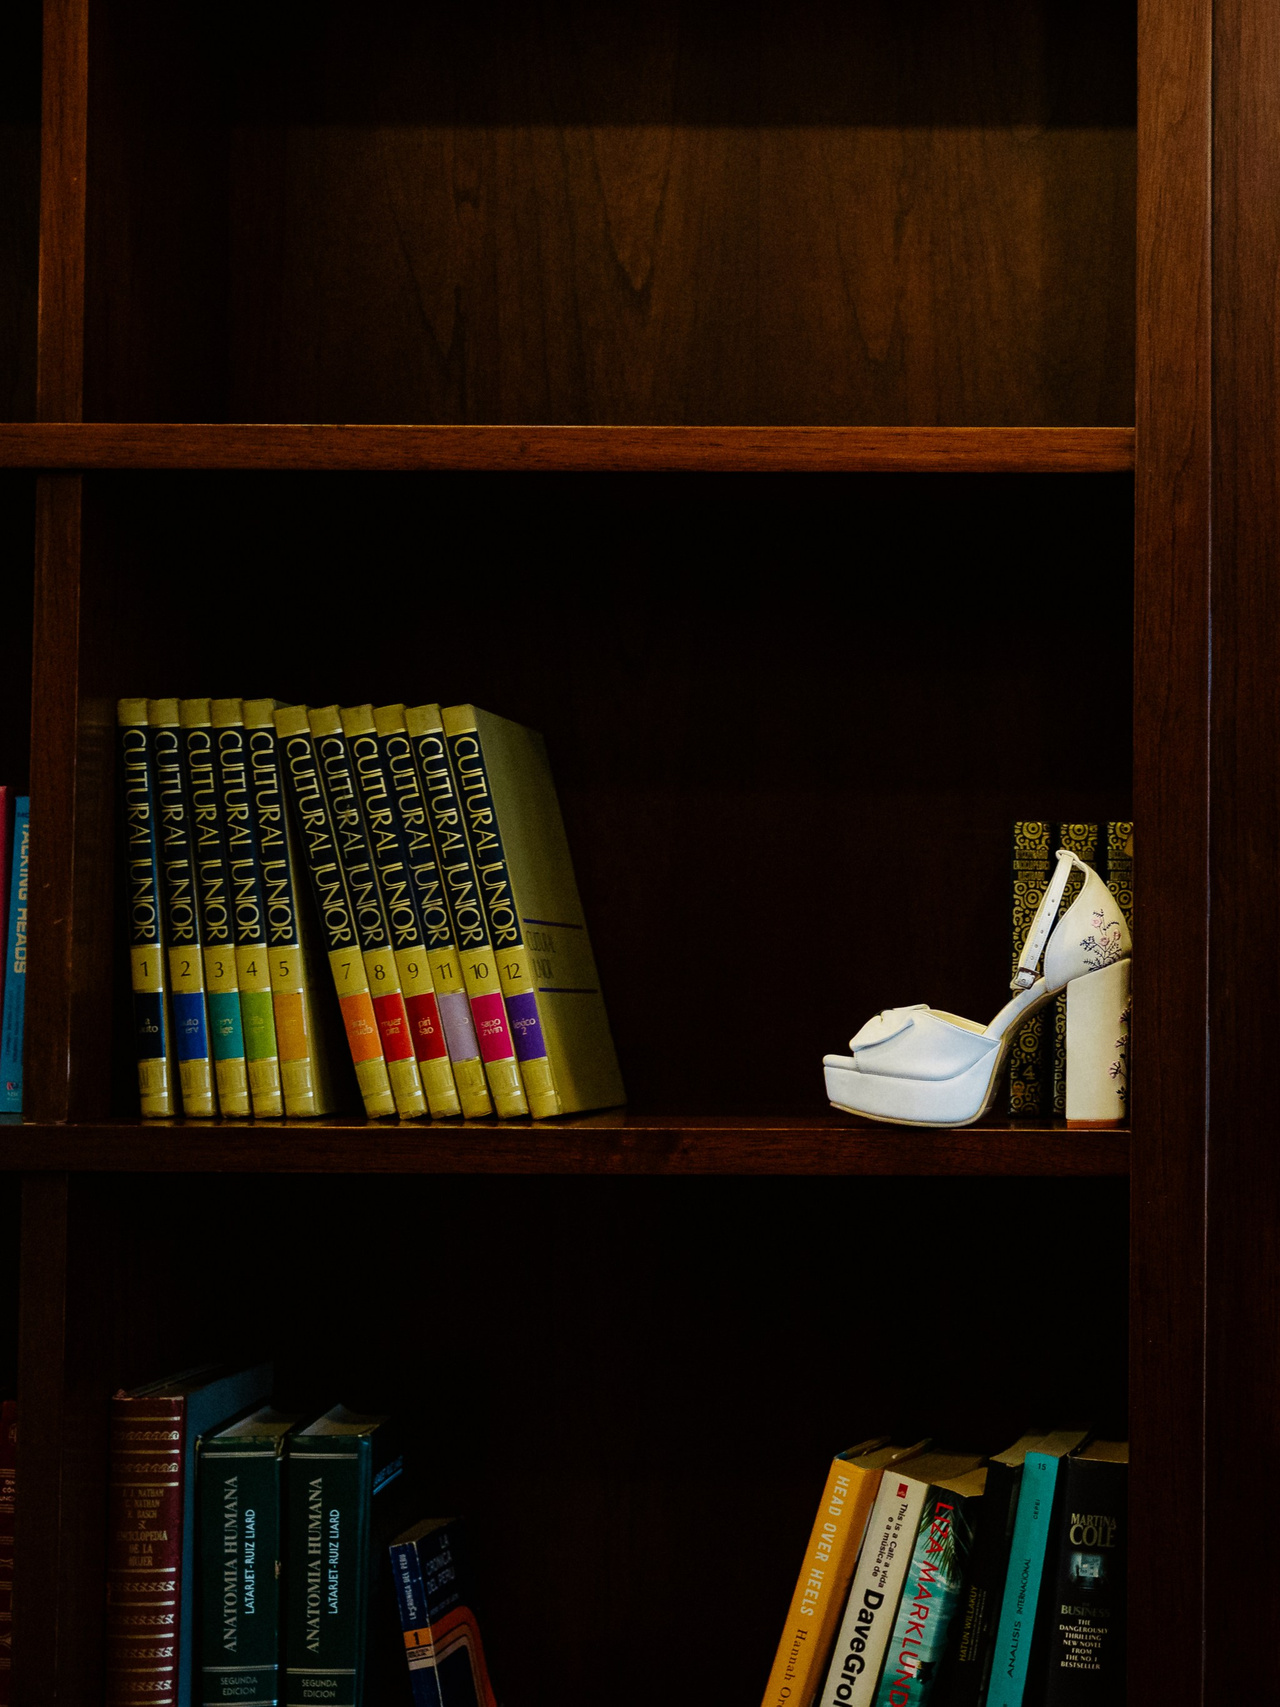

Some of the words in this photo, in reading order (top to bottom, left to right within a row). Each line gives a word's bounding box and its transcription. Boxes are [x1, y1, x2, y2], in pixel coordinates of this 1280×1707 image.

[122, 730, 151, 852] CULTURAL
[154, 730, 187, 853] CULTURAL
[187, 730, 220, 853] CULTURAL
[218, 730, 252, 853] CULTURAL
[250, 731, 284, 854] CULTURAL
[286, 737, 332, 859] CULTURAL
[309, 862, 352, 947] JUNIOR
[320, 737, 365, 859] CULTURAL
[344, 862, 385, 946] JUNIOR
[353, 737, 399, 858] CULTURAL
[377, 862, 418, 946] JUNIOR
[386, 737, 431, 858] CULTURAL
[409, 862, 450, 946] JUNIOR
[418, 737, 465, 858] CULTURAL
[442, 862, 484, 946] JUNIOR
[454, 736, 499, 858] CULTURAL
[477, 862, 518, 946] JUNIOR
[129, 858, 156, 940] JUNIOR
[164, 859, 194, 942] JUNIOR
[198, 858, 229, 942] JUNIOR
[229, 858, 261, 942] JUNIOR
[260, 859, 293, 943] JUNIOR
[140, 961, 149, 977] 1
[180, 960, 191, 977] 2
[214, 961, 224, 978] 3
[246, 961, 258, 976] 4
[279, 960, 289, 977] 5
[341, 962, 351, 980] 7
[374, 964, 386, 981] 8
[407, 962, 419, 979] 9
[437, 962, 453, 980] 11
[471, 962, 489, 980] 10
[503, 962, 521, 980] 12
[418, 1017, 431, 1029] piri
[419, 1026, 434, 1035] sao
[480, 1018, 501, 1029] sapo
[1022, 1064, 1035, 1080] 4
[828, 1475, 851, 1517] HEAD
[223, 1476, 238, 1554] HUMANA
[244, 1509, 256, 1539] LIARD
[307, 1477, 323, 1556] HUMANA
[328, 1509, 340, 1539] LIARD
[894, 1523, 901, 1531] is
[896, 1503, 909, 1521] This
[926, 1501, 954, 1553] LIZA
[1070, 1513, 1117, 1530] MARTINA
[815, 1522, 837, 1563] OVER
[877, 1535, 890, 1565] música
[1069, 1524, 1117, 1548] COLE
[244, 1541, 256, 1614] LATARJET-RUIZ
[328, 1541, 339, 1614] LATARJET-RUIZ
[872, 1565, 880, 1577] de
[878, 1570, 889, 1588] vida
[223, 1558, 238, 1653] ANATOMIA
[306, 1559, 322, 1653] ANATOMIA
[800, 1568, 825, 1617] HEELS
[1006, 1620, 1021, 1678] ANALISIS
[1018, 1558, 1032, 1614] INTERNACIONAL
[1060, 1604, 1111, 1618] BUSINESS
[889, 1560, 939, 1707] MARKLUND
[1059, 1624, 1109, 1634] DANGEROUSLY
[1063, 1639, 1078, 1647] NEW
[1079, 1641, 1102, 1649] NOVEL
[1064, 1633, 1102, 1641] THRILLING
[784, 1629, 808, 1684] Hannah
[1060, 1661, 1101, 1669] BESTSELLER
[220, 1676, 258, 1686] SEGUNDA
[222, 1687, 256, 1696] EDICION
[301, 1679, 338, 1688] SEGUNDA
[303, 1690, 335, 1698] EDICION
